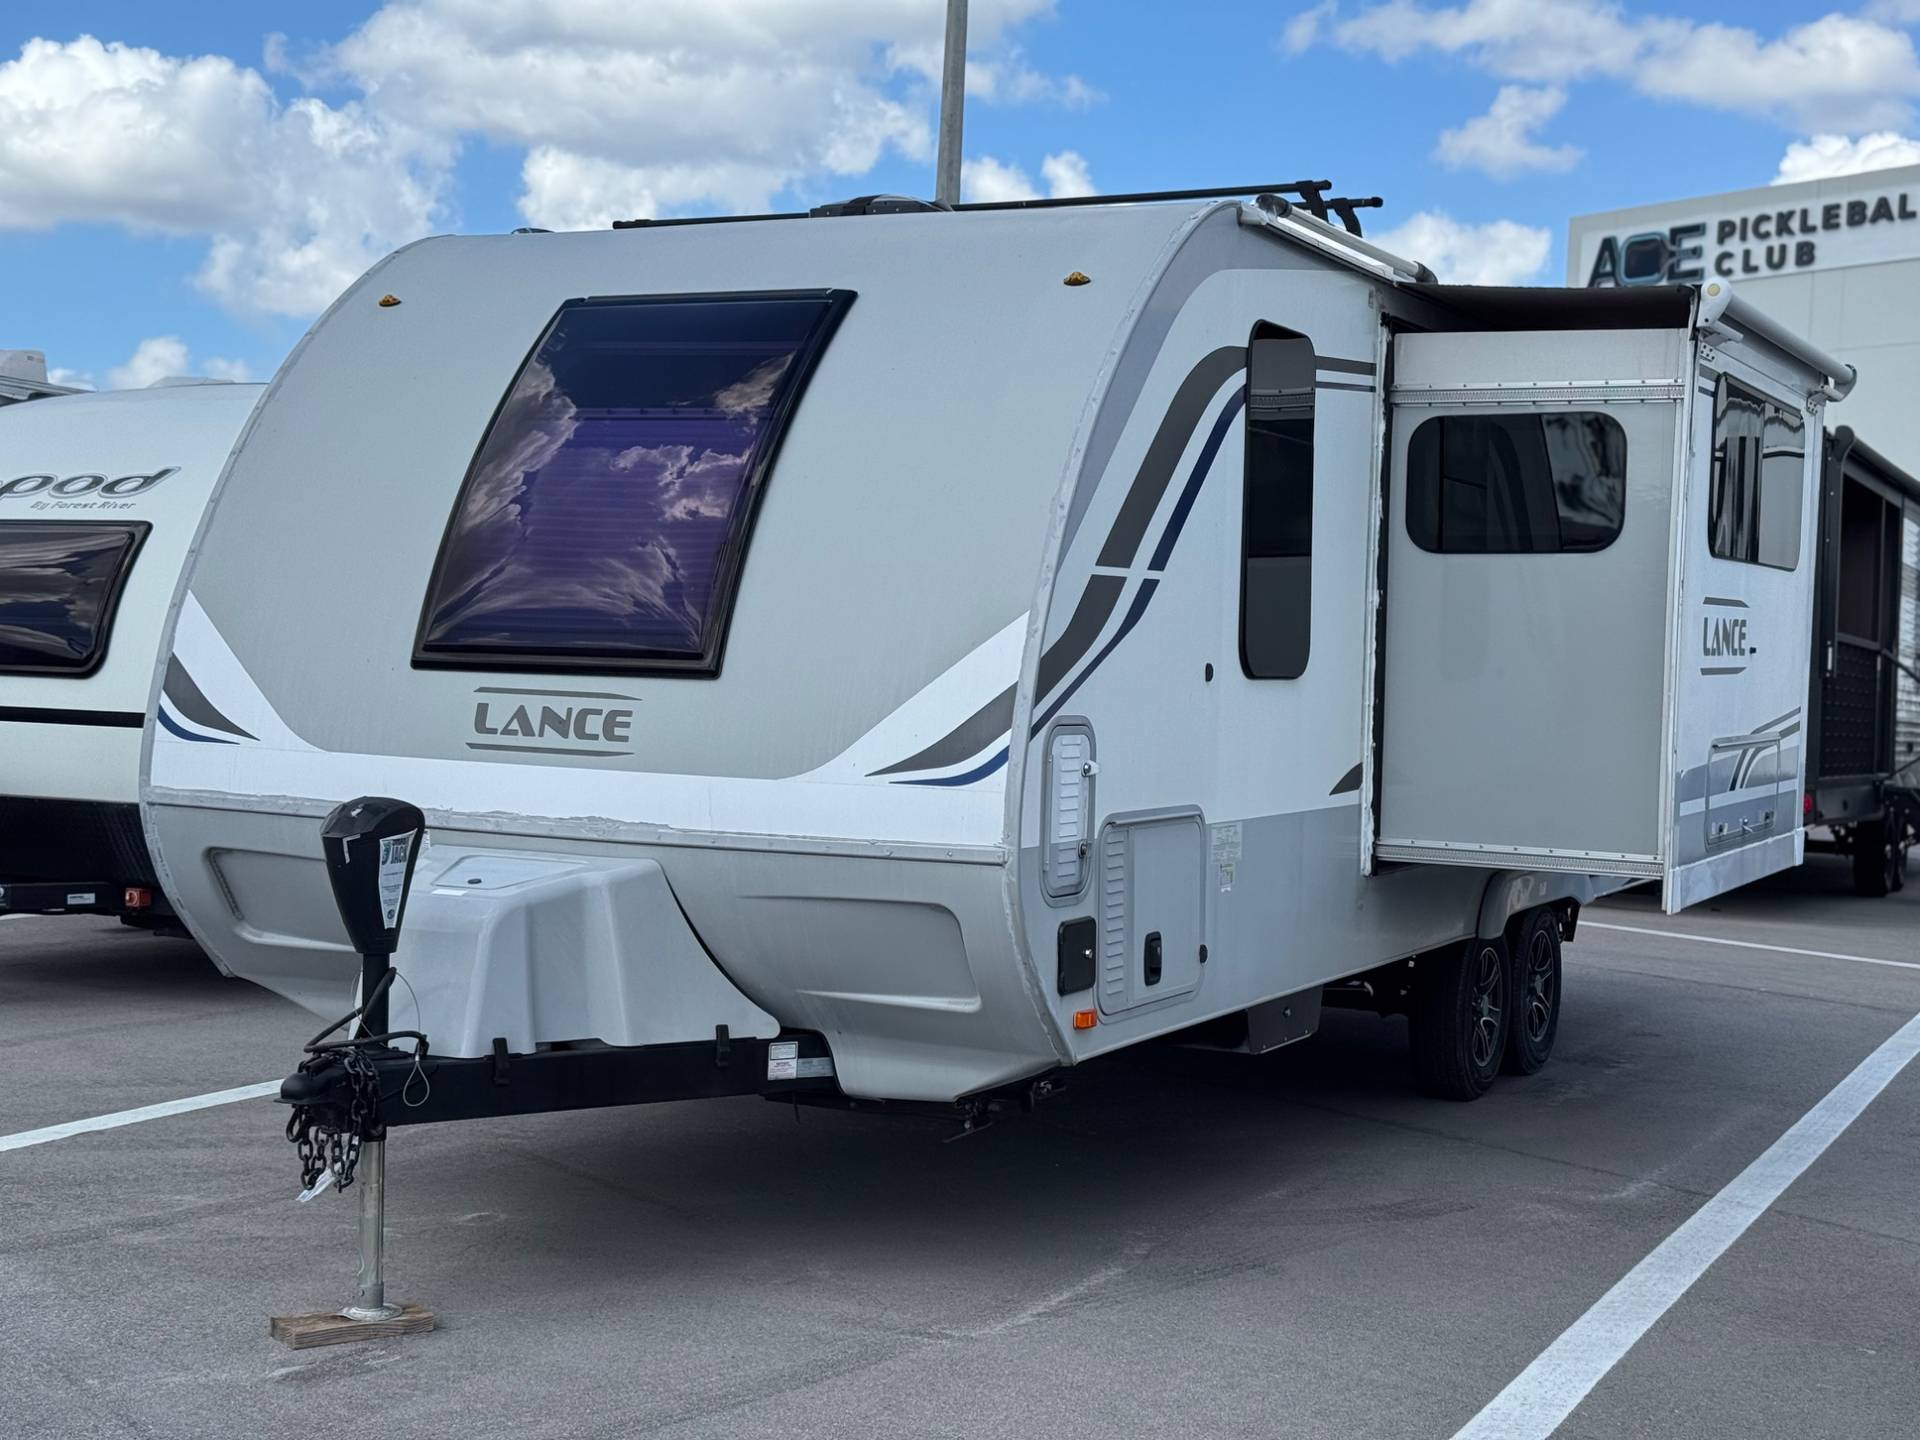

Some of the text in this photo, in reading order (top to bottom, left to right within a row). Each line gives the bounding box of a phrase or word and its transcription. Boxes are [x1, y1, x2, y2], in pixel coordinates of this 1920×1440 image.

[1587, 222, 1706, 287] ACE
[1714, 241, 1816, 277] CLUB
[51, 501, 98, 509] Forest
[97, 501, 136, 509] River
[1703, 617, 1747, 656] LANCE
[474, 702, 633, 742] LANCE
